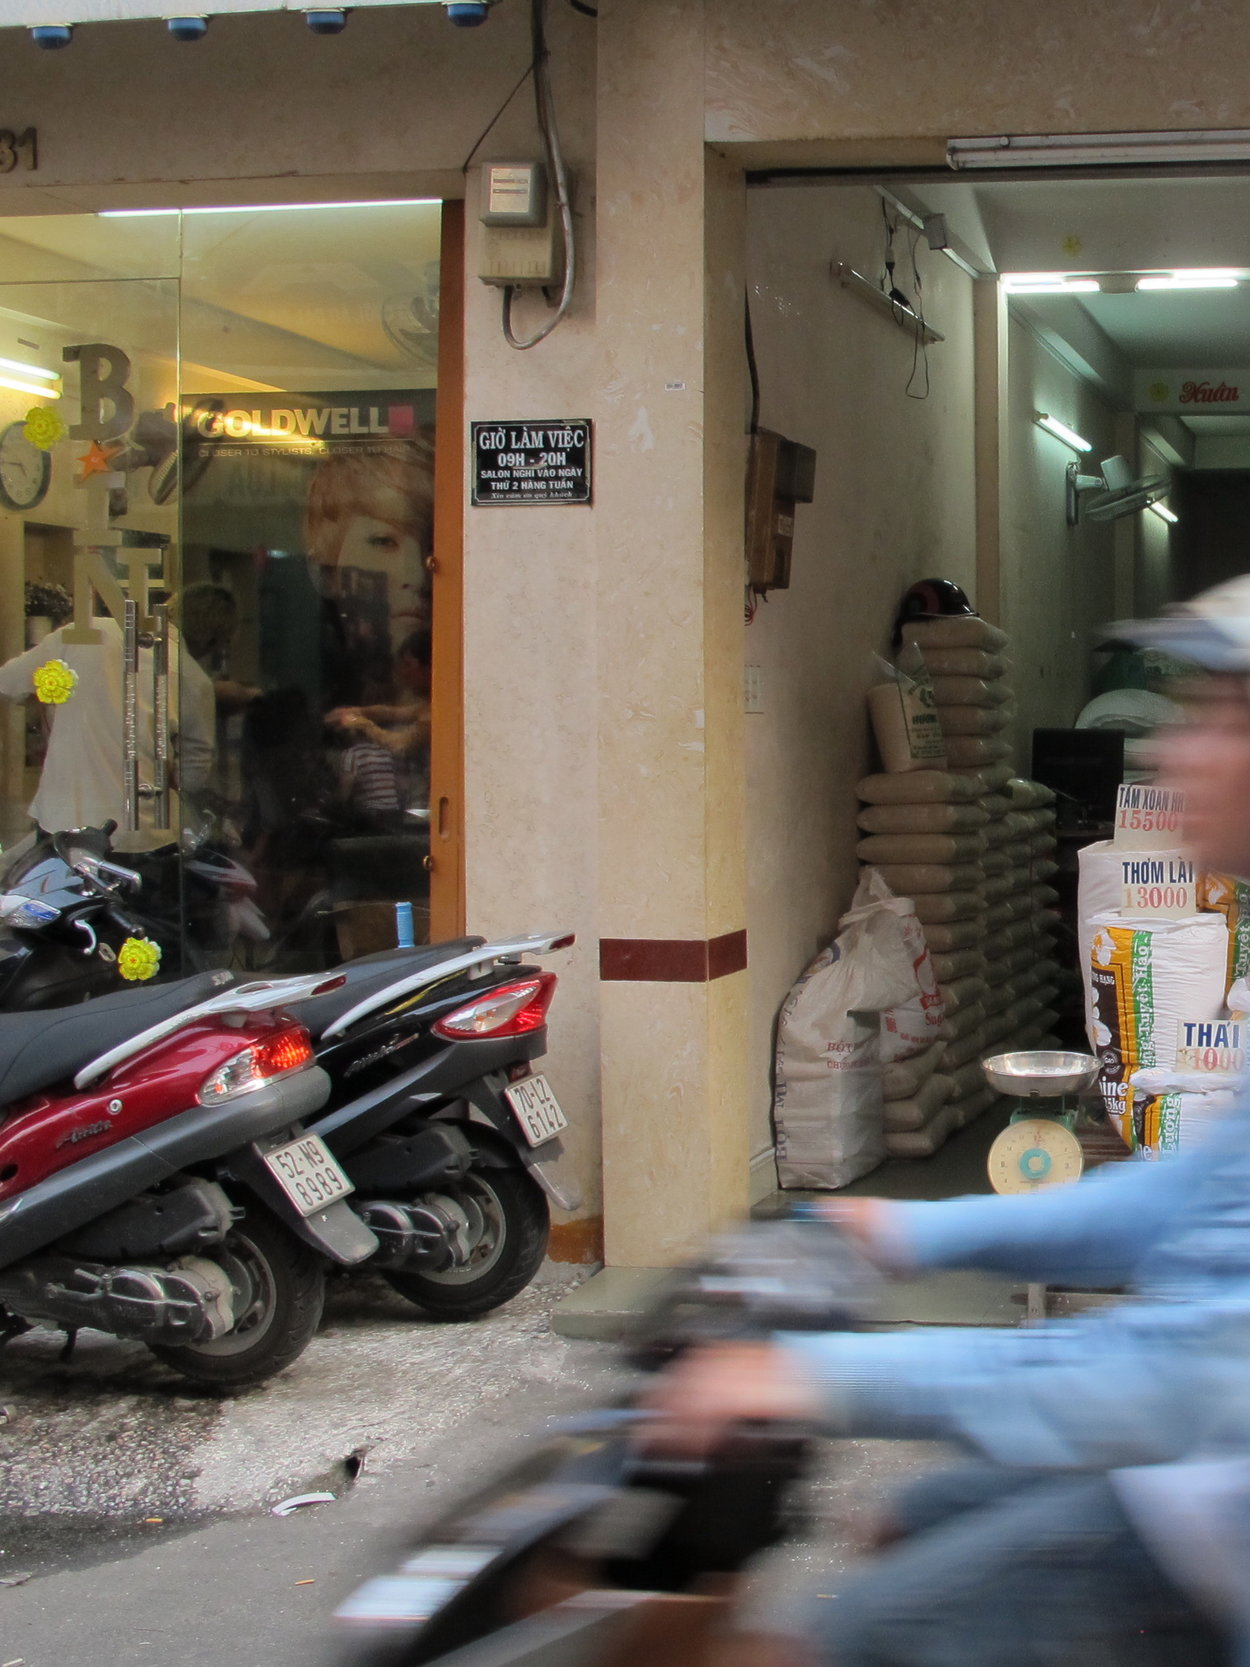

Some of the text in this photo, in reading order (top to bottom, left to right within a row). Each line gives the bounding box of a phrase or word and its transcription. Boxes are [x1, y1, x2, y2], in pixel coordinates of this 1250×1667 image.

[197, 406, 390, 439] GOLDWELL
[480, 426, 584, 452] GIỜ LÀM VIỆC
[498, 453, 525, 467] 09H
[539, 452, 567, 466] 20H
[481, 470, 511, 479] SALON
[537, 467, 556, 478] VÀO
[512, 482, 519, 490] 2
[521, 480, 547, 490] HÀNG
[1119, 809, 1178, 832] 15500
[1122, 856, 1194, 885] THƠM LÀI
[1123, 887, 1188, 909] 13000
[1184, 1021, 1241, 1049] THÁI
[278, 1140, 325, 1179] 52-N9
[295, 1167, 343, 1207] 8989
